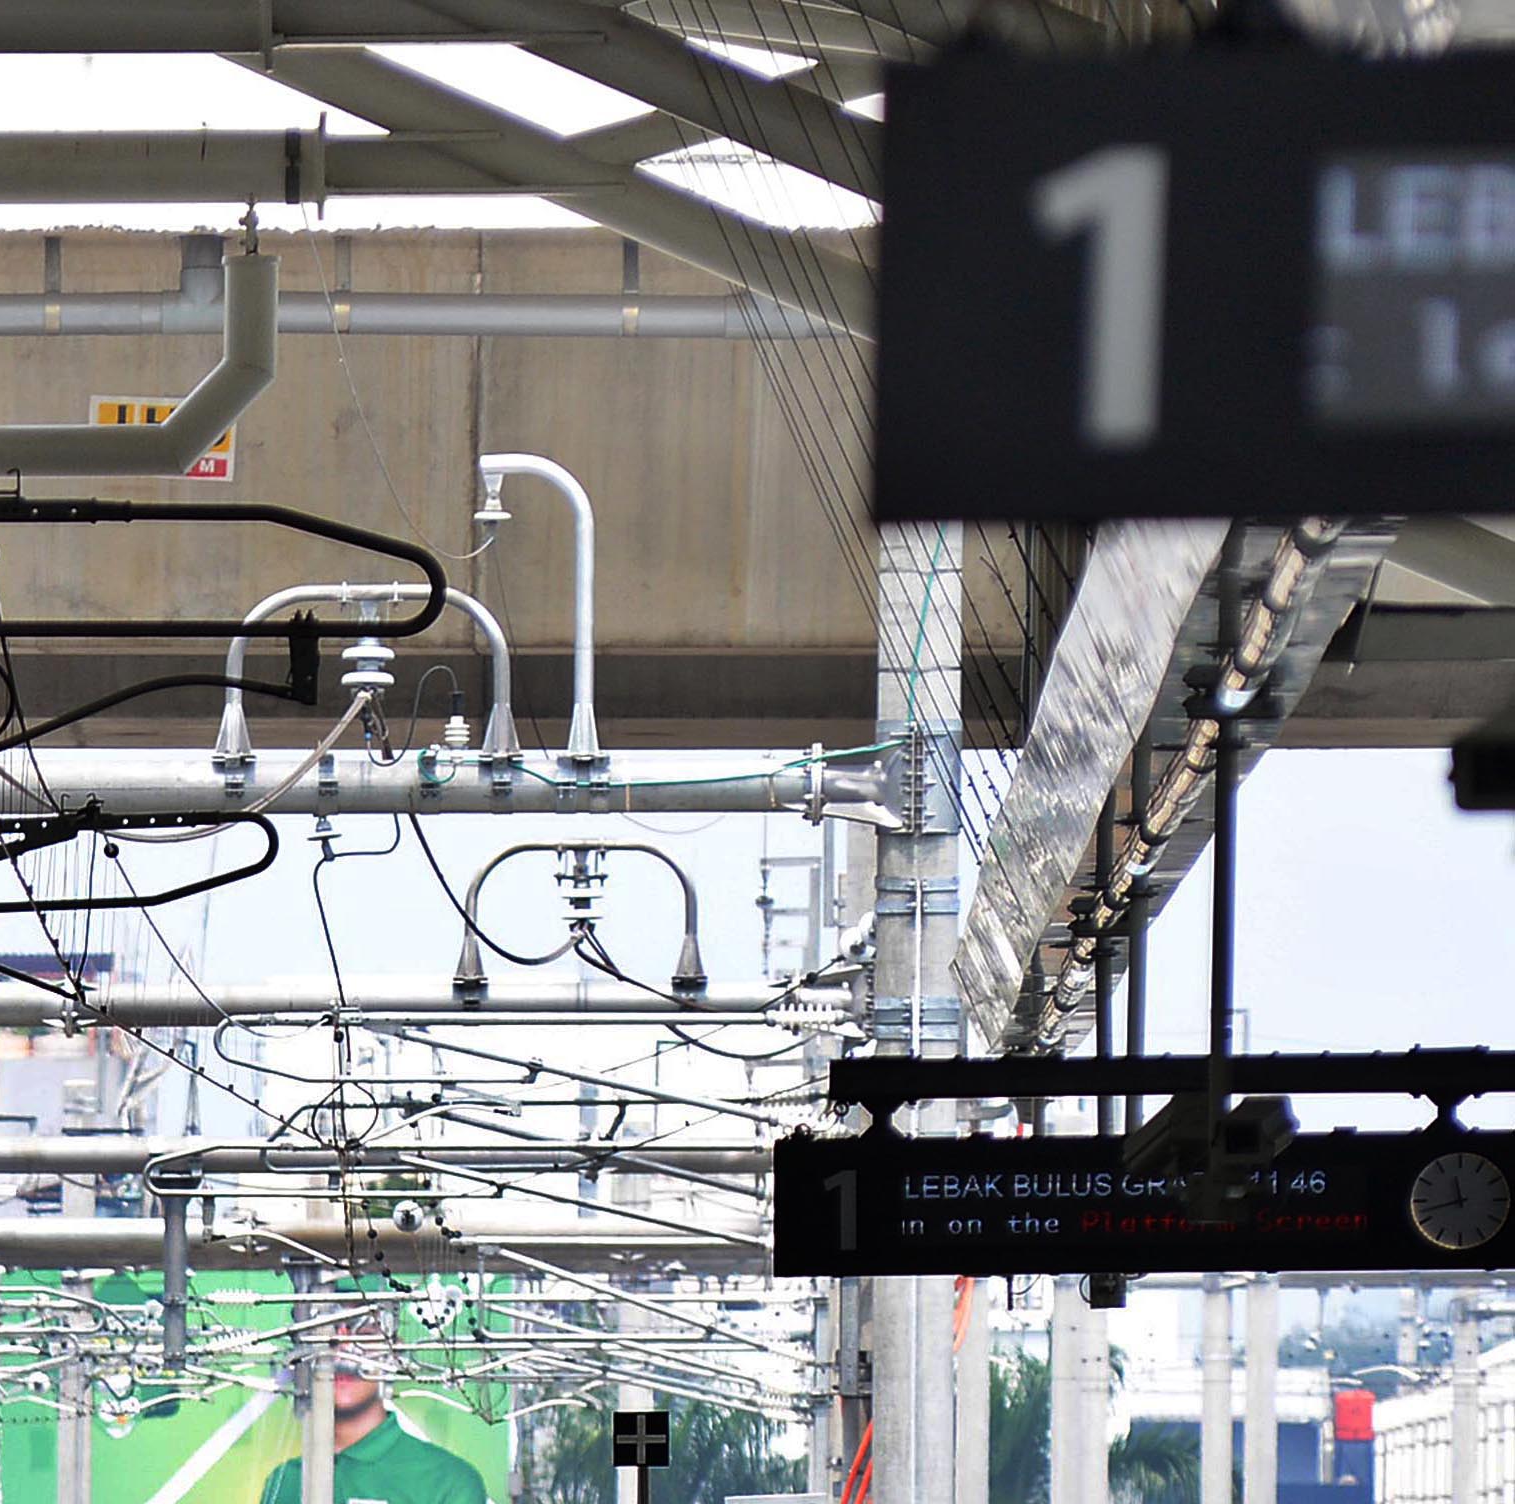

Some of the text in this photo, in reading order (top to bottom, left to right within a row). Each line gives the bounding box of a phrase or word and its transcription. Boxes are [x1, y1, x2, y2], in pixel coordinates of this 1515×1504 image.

[1034, 145, 1170, 449] 1
[823, 1170, 857, 1251] 1
[905, 1174, 1004, 1199] LEBAK
[1014, 1172, 1113, 1198] BULUS
[948, 1217, 983, 1236] on
[1008, 1211, 1061, 1234] the
[1257, 1208, 1369, 1233] Screen
